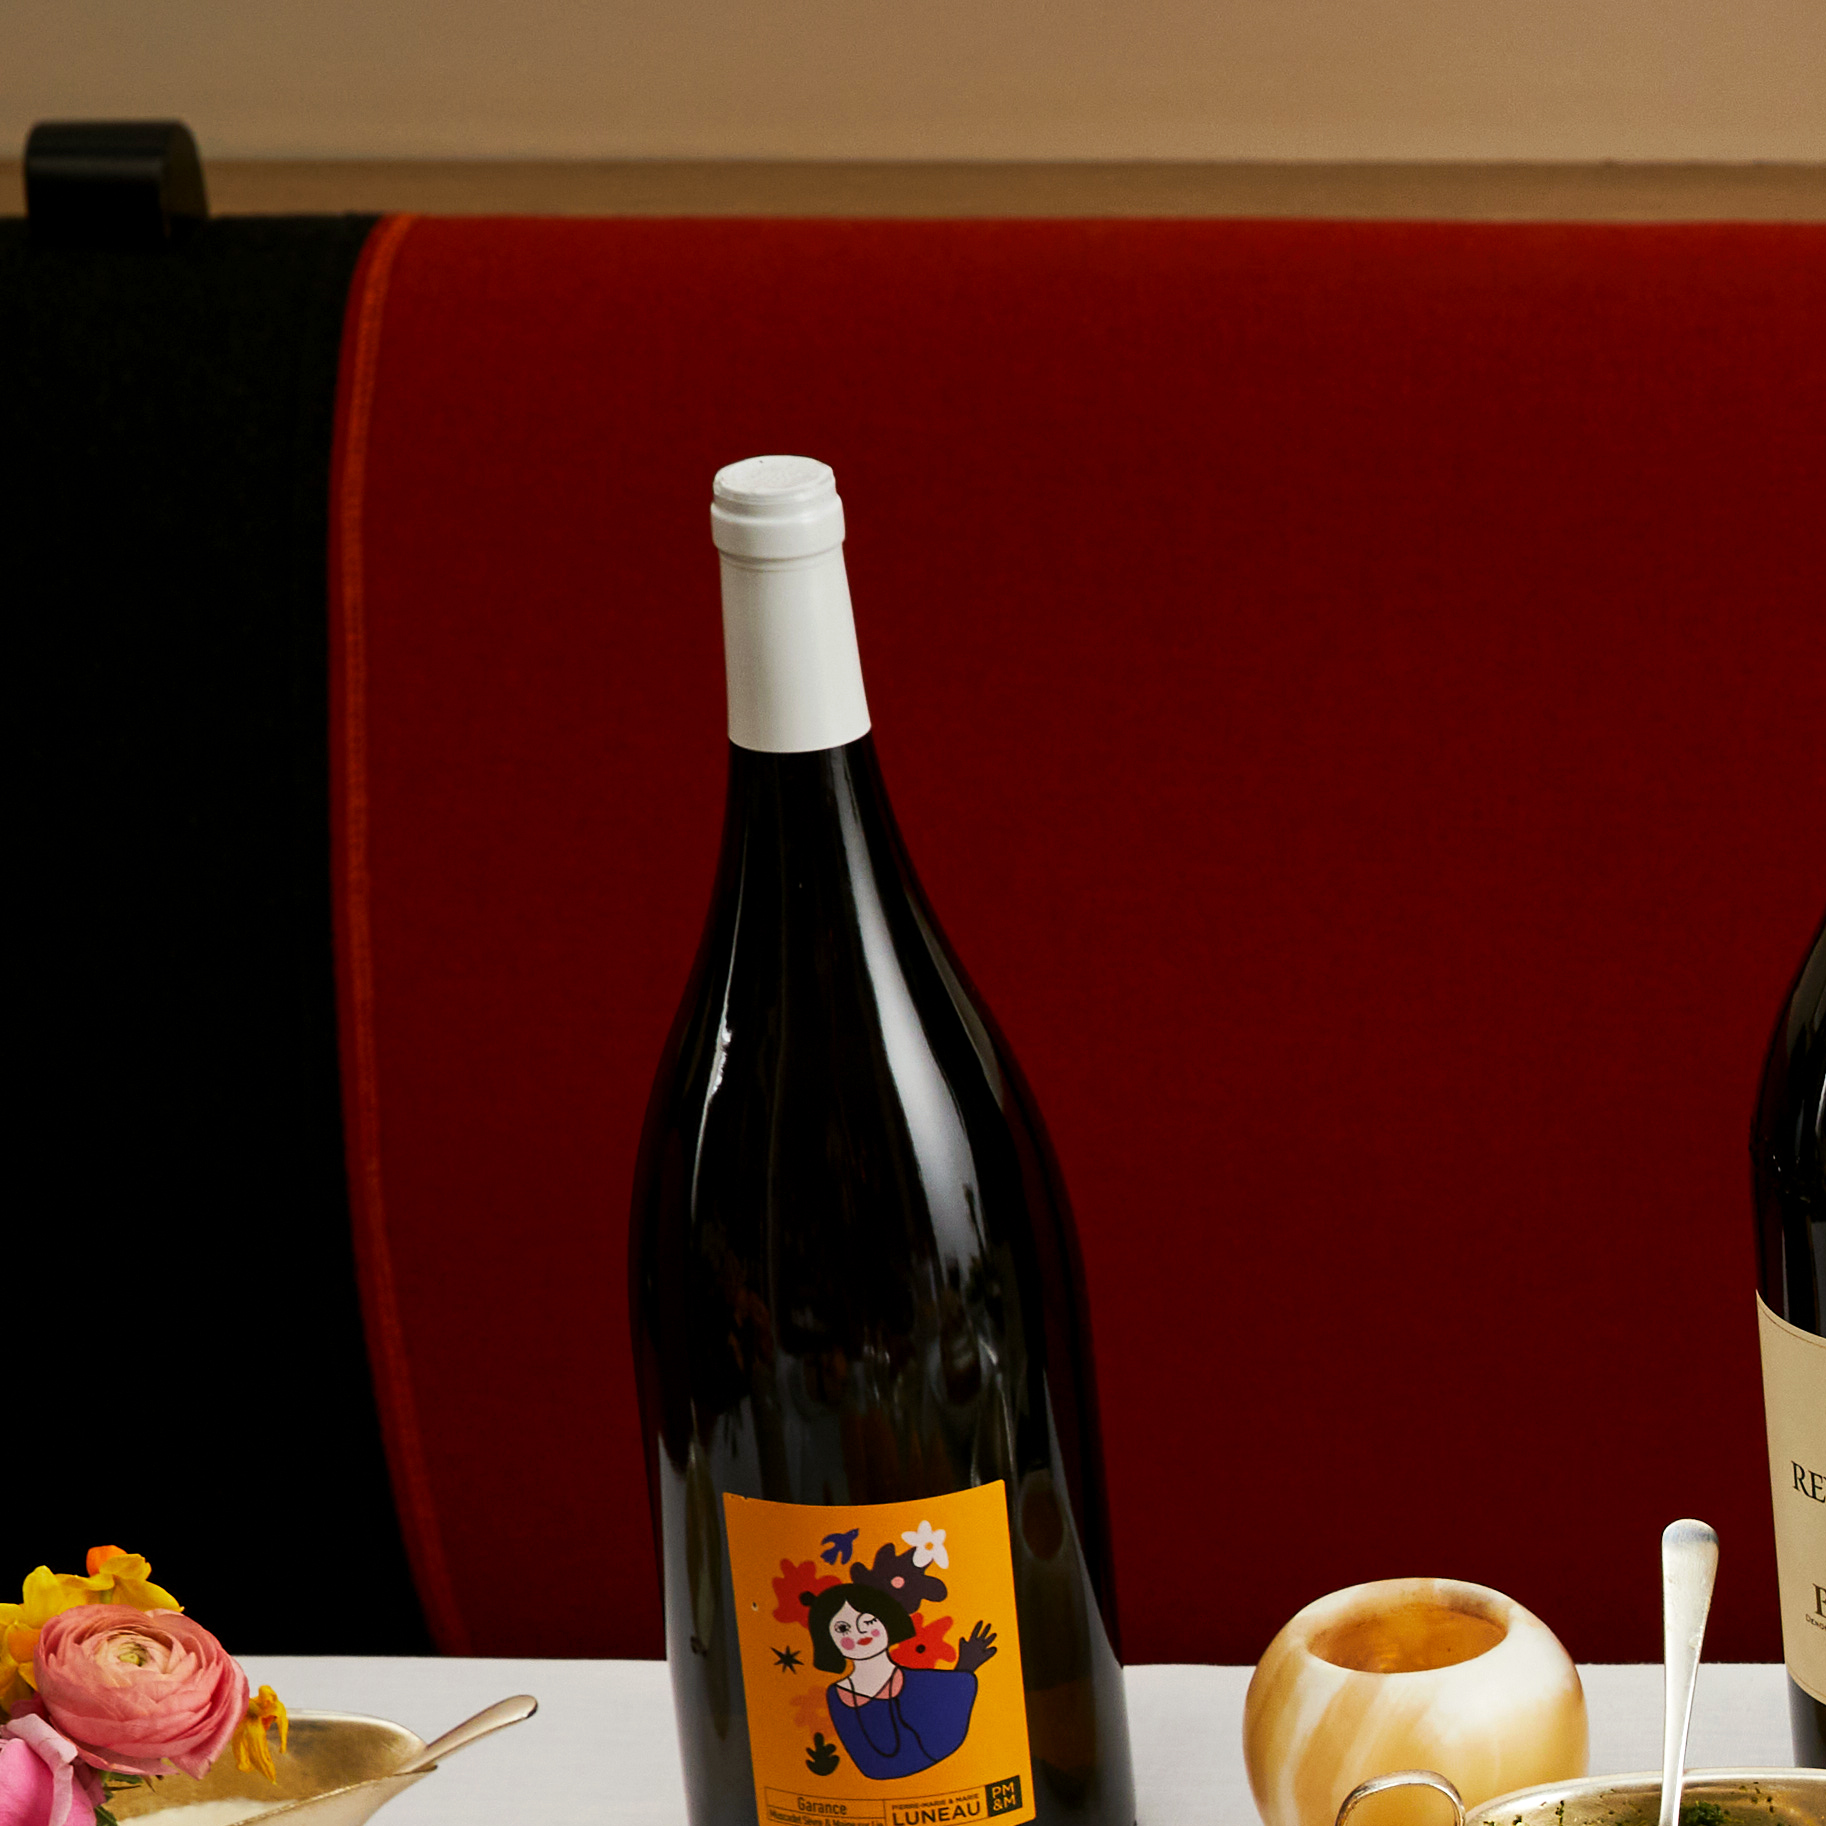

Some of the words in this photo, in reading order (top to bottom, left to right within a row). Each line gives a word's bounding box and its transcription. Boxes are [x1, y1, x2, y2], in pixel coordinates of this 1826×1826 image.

[991, 1781, 1015, 1799] PM
[797, 1796, 847, 1815] Garance
[992, 1795, 1016, 1811] &M
[892, 1801, 980, 1826] LUNEAU
